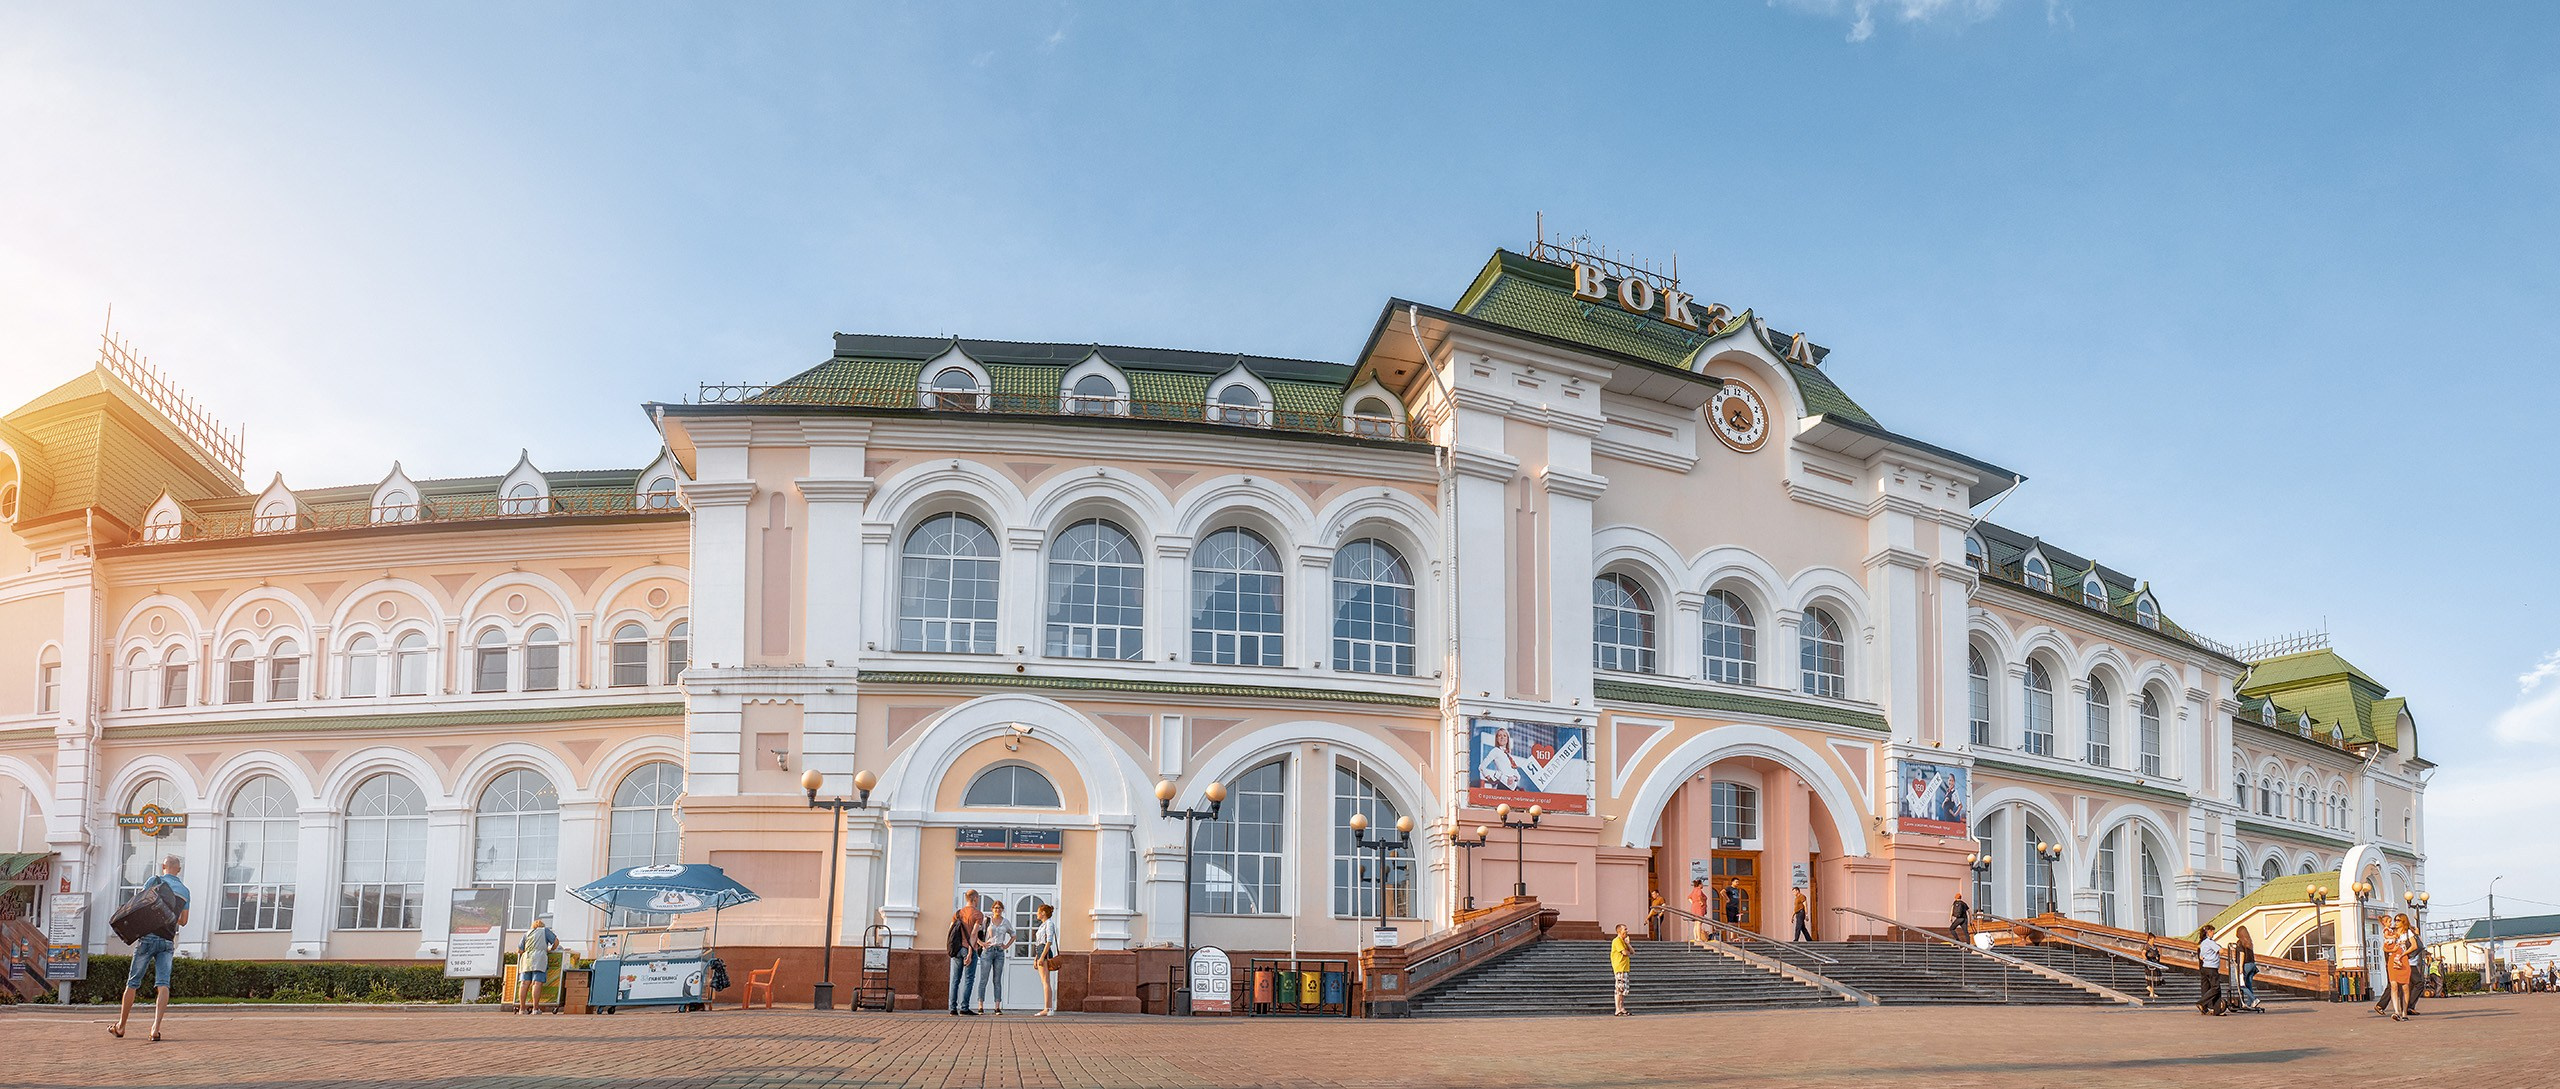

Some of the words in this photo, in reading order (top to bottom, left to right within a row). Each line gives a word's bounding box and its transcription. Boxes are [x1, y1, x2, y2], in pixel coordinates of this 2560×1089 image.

[1734, 388, 1741, 396] 12
[1718, 417, 1723, 425] 8
[1756, 417, 1761, 425] 3
[1536, 750, 1550, 760] 160
[1527, 761, 1539, 775] Я
[147, 816, 154, 825] &
